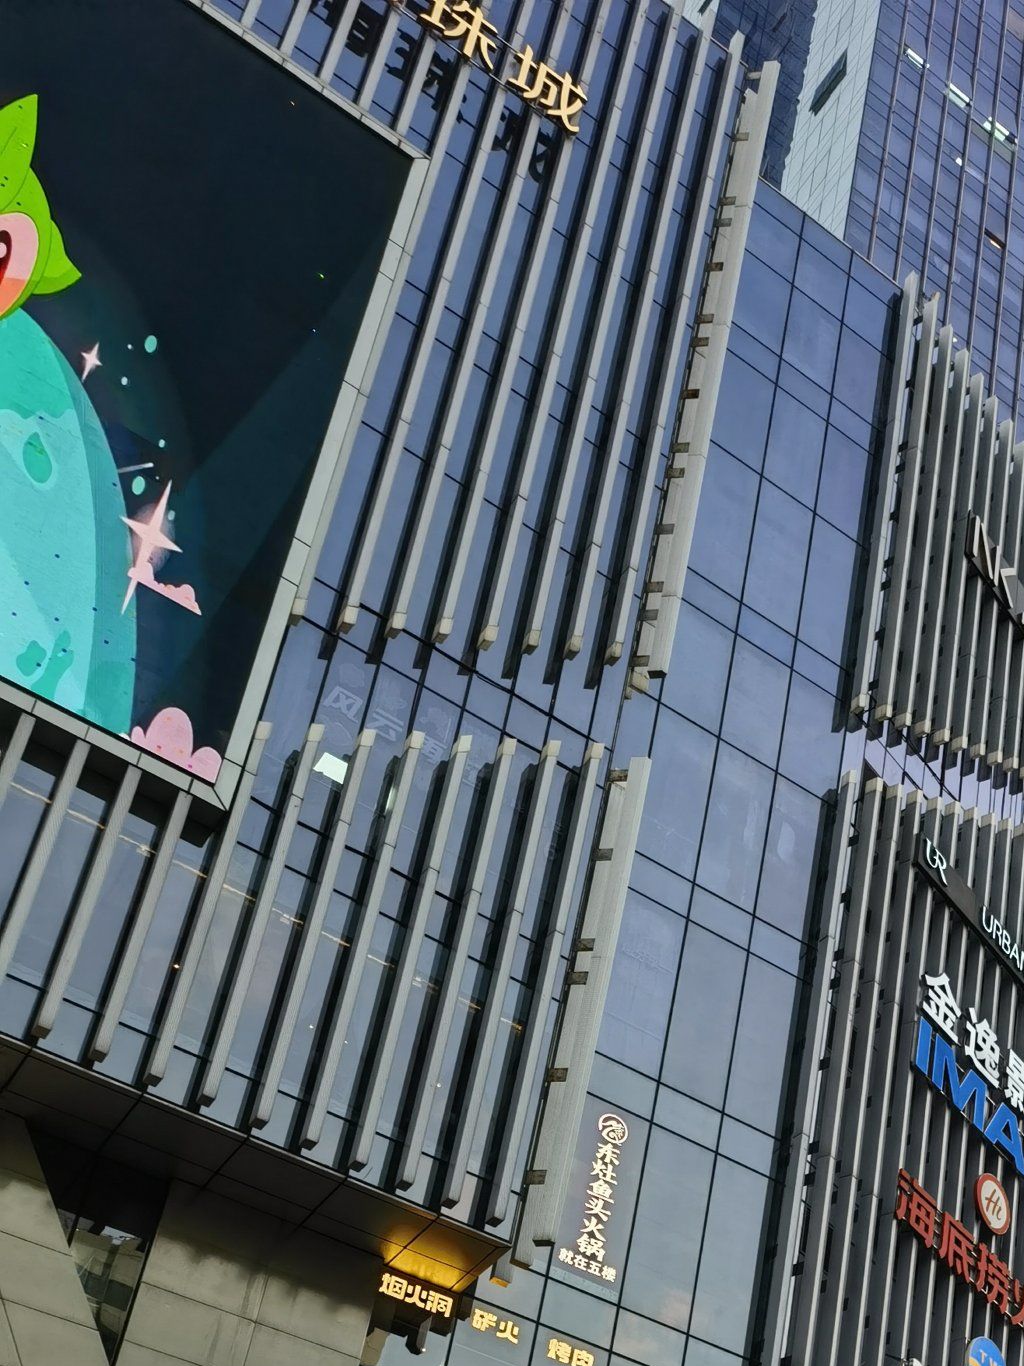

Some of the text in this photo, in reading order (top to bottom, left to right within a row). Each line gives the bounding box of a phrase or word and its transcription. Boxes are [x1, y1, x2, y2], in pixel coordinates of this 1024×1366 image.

[575, 1142, 621, 1263] 东灶鱼头火锅
[558, 1247, 617, 1283] 就在五楼
[378, 1272, 454, 1318] 烟火洞
